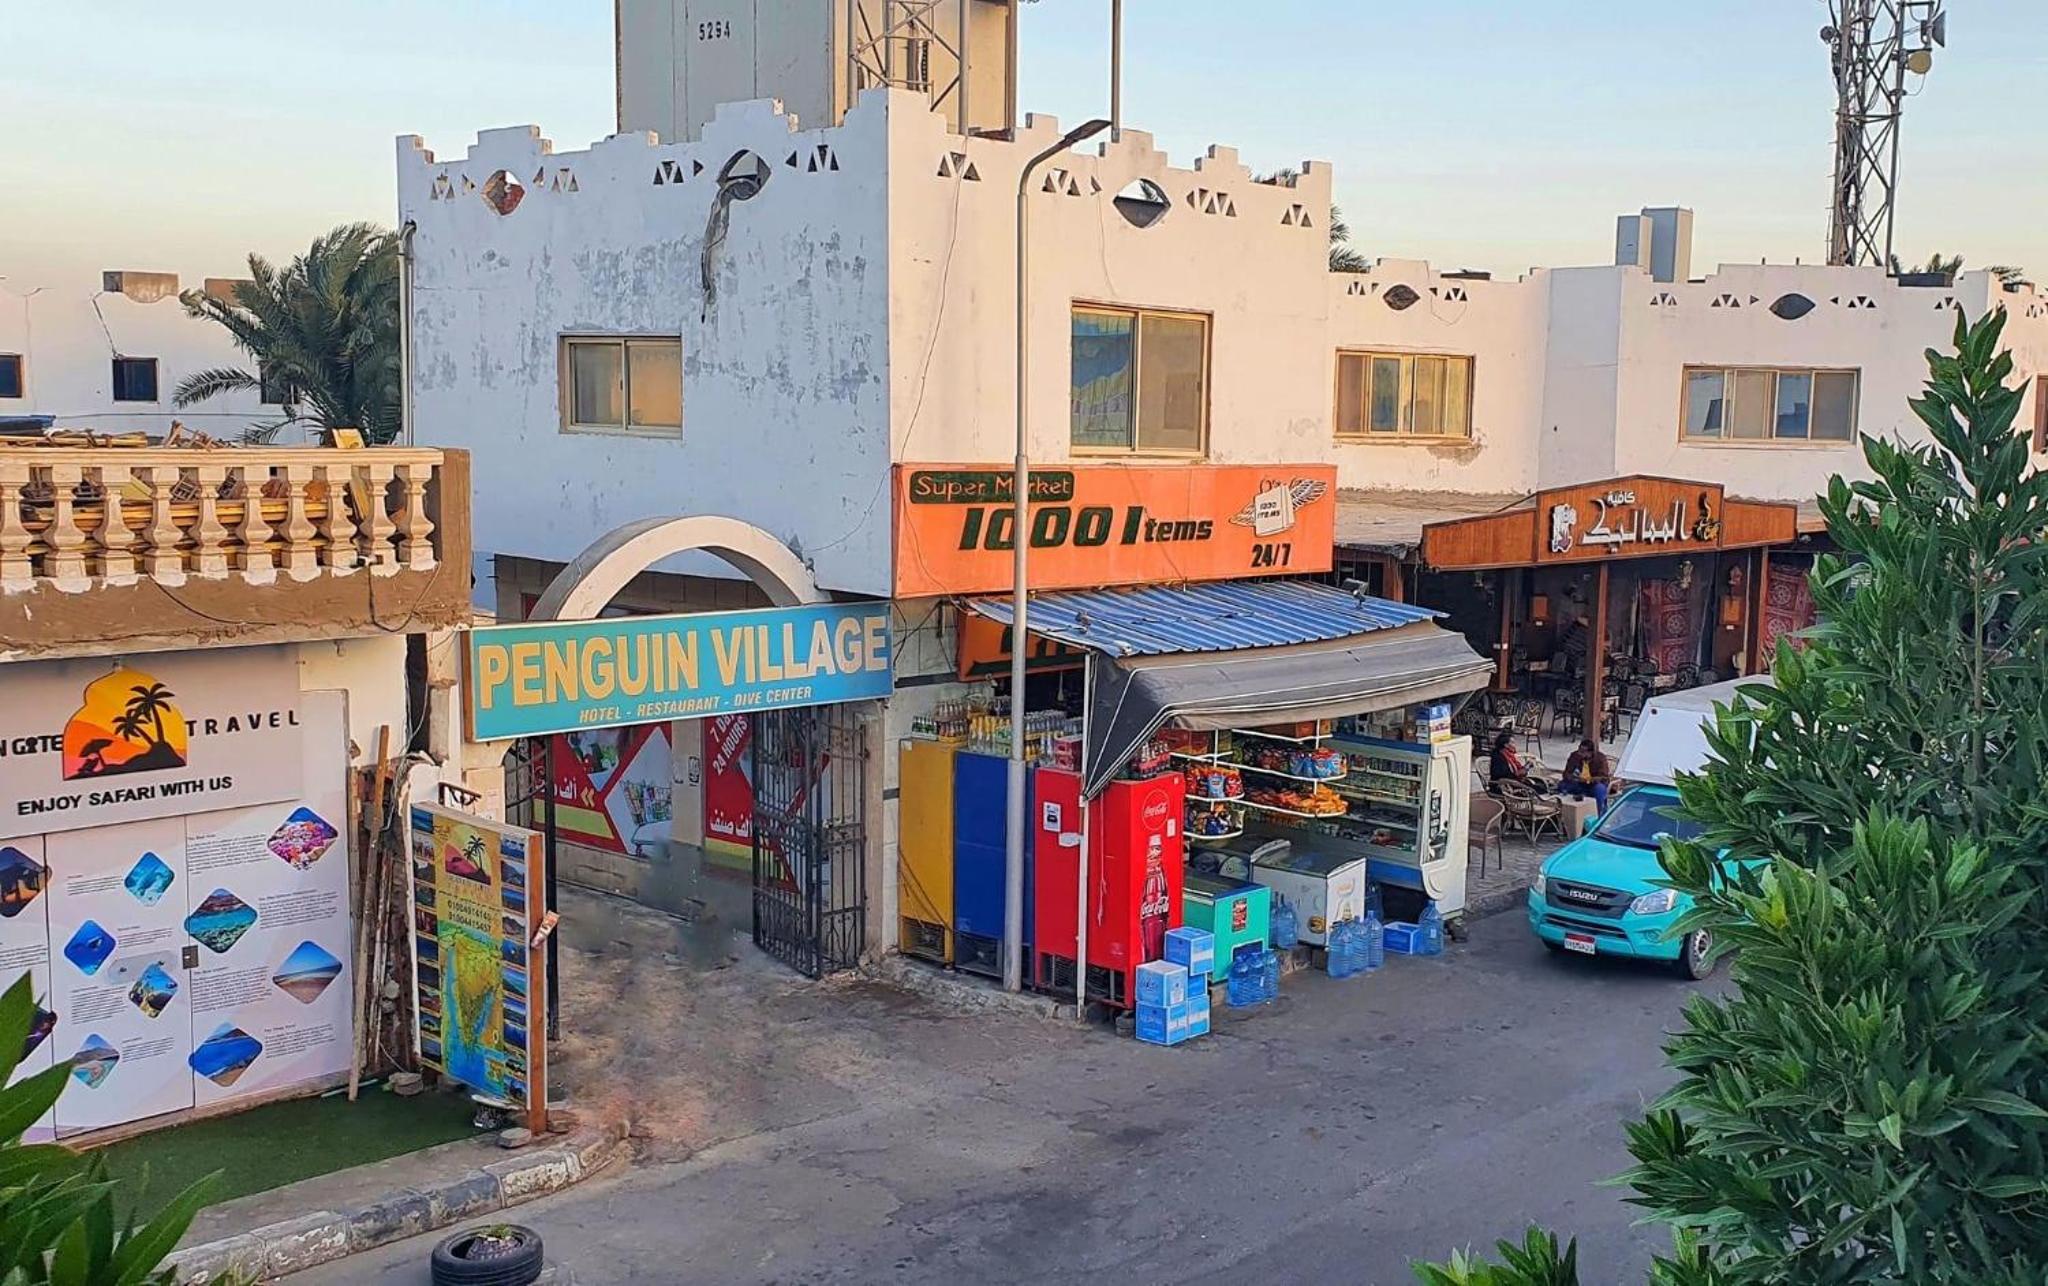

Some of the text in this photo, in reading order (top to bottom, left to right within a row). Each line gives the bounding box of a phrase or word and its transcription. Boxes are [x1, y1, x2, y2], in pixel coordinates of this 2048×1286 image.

[699, 21, 730, 41] 5294
[914, 475, 1071, 501] Super Mrket
[958, 505, 1214, 550] 1000 Items
[1251, 543, 1291, 568] 24/7
[478, 628, 699, 709] PENGUIN
[710, 614, 889, 687] VILLAGE
[580, 685, 812, 723] HOTEL RESTAURANT DIVE CENTER
[185, 710, 300, 737] TRAVEL
[710, 727, 720, 743] 7
[712, 716, 748, 776] 24 HOURS
[17, 776, 233, 816] ENJOY SAFARI WITH US
[1569, 889, 1598, 901] ISUZU
